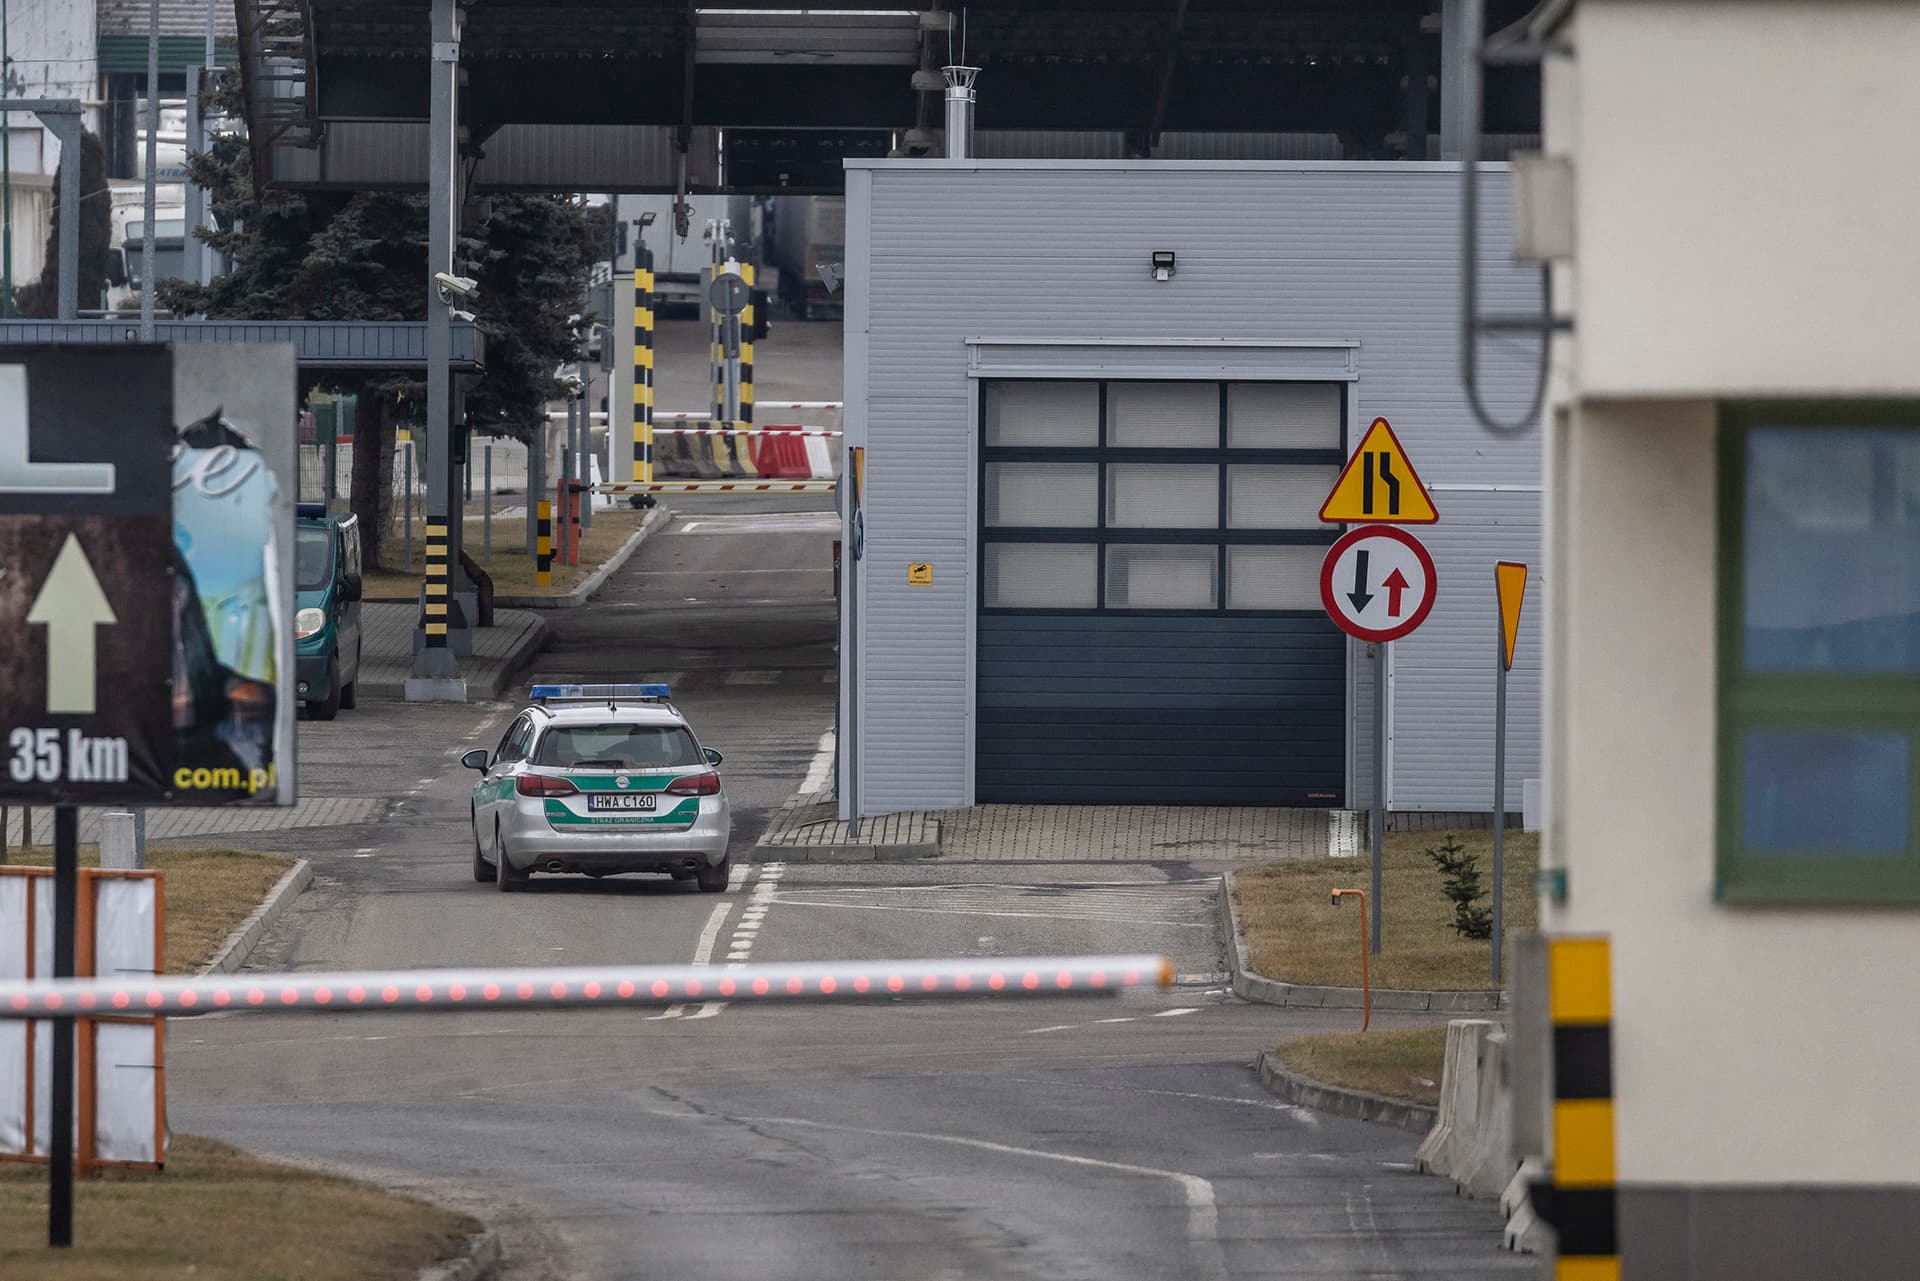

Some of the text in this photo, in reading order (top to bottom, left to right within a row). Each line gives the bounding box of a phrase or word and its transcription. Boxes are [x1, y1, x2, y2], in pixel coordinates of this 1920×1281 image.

[9, 727, 129, 782] 35 km
[173, 762, 276, 793] com.pl
[596, 796, 619, 807] HWA
[623, 796, 653, 807] C160
